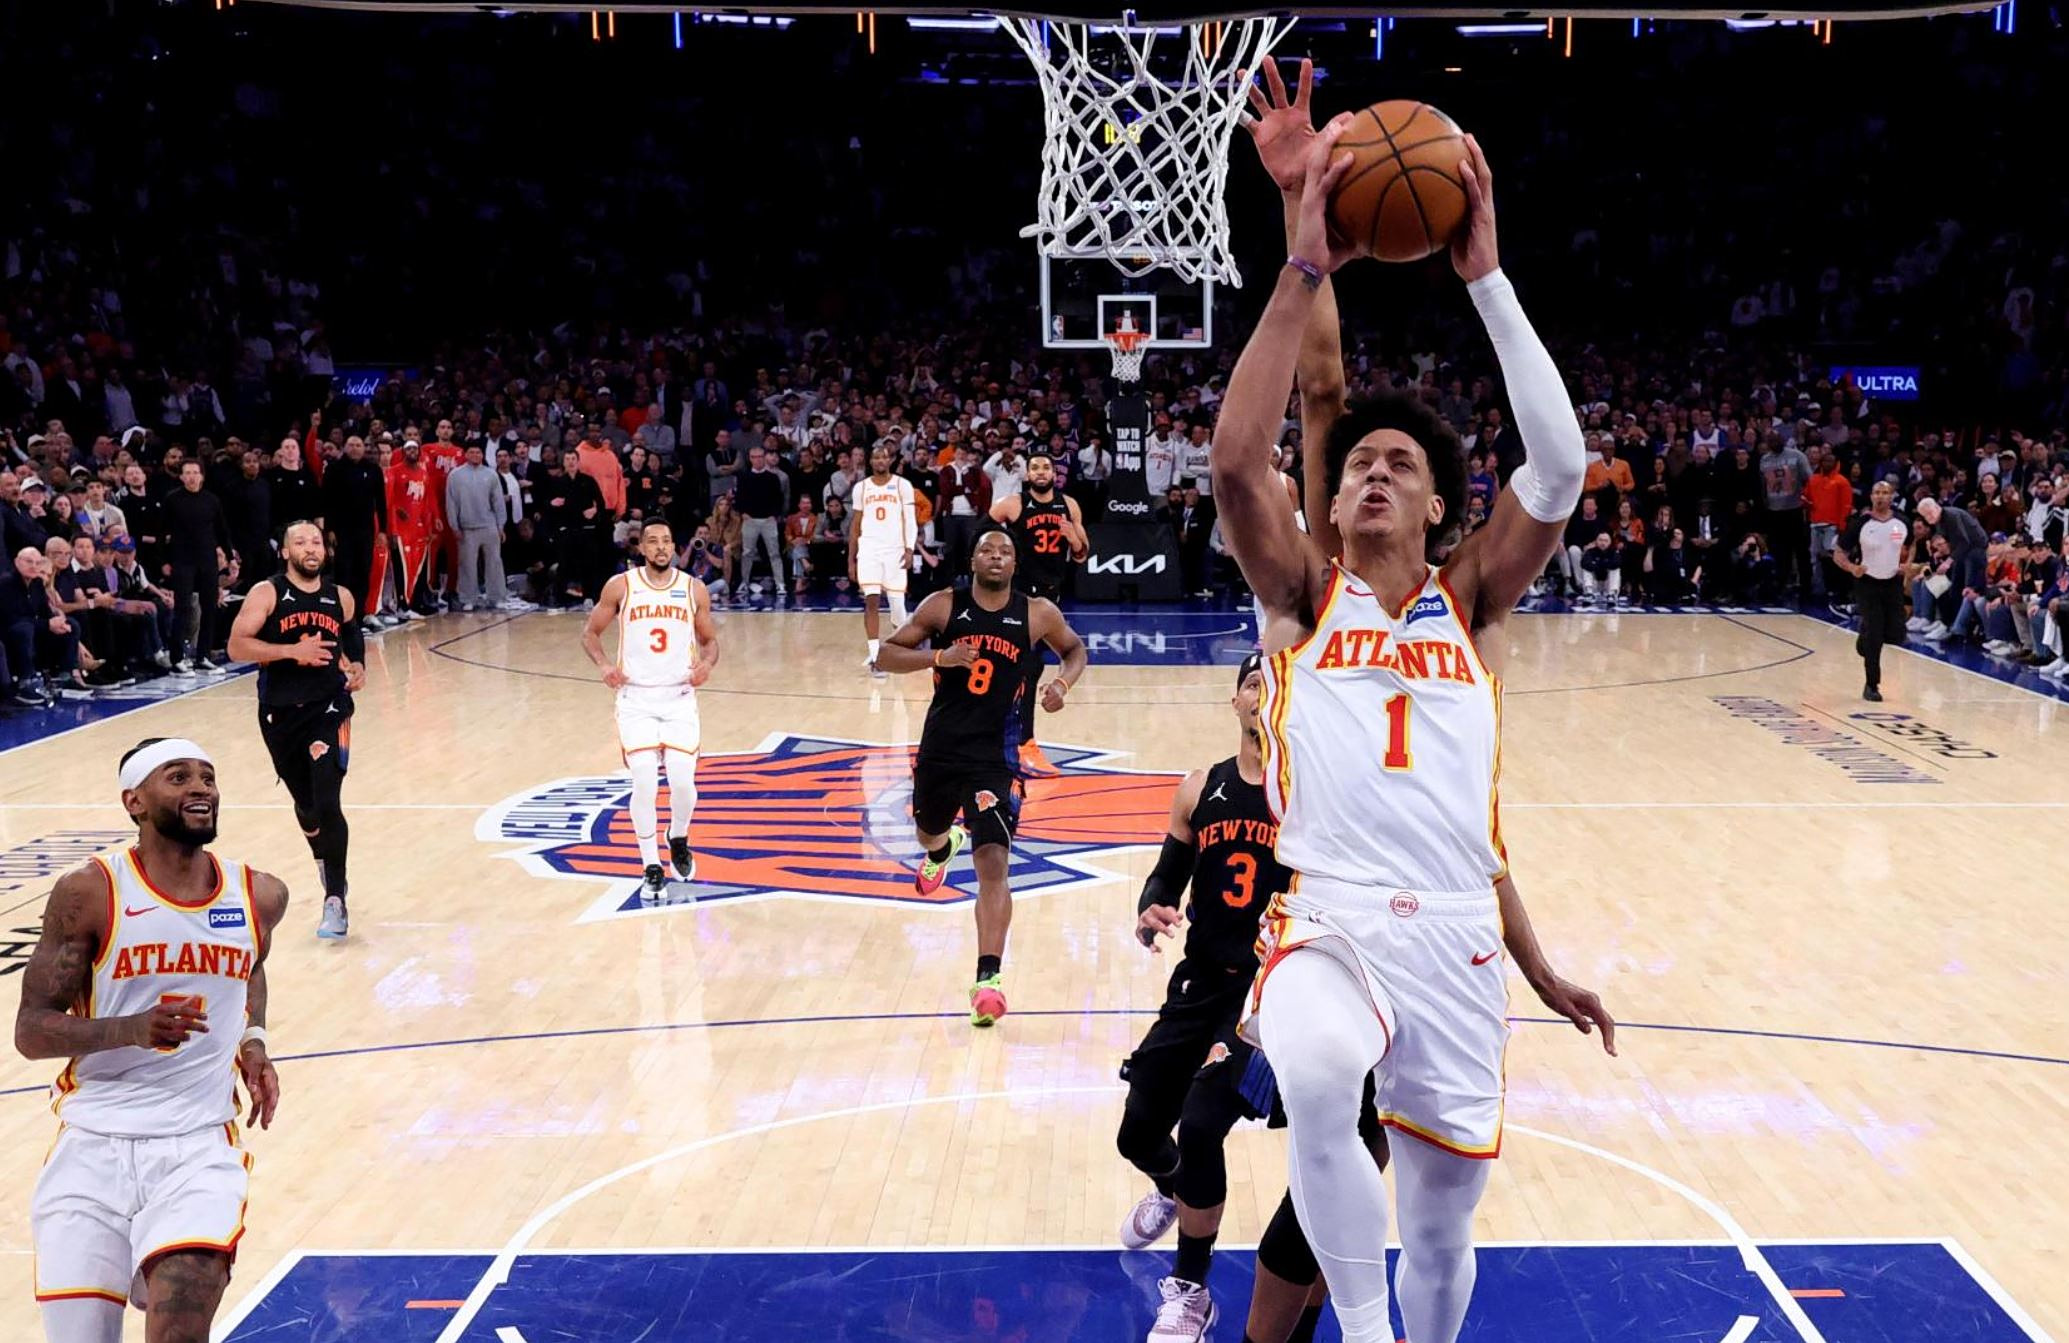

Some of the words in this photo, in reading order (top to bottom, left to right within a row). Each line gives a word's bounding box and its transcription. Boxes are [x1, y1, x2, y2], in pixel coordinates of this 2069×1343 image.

[1857, 376, 1918, 391] ULTRA
[1116, 428, 1130, 440] TAP
[1131, 428, 1140, 440] TO
[1116, 440, 1141, 452] WATCH
[865, 494, 898, 505] ATLANTA
[1108, 500, 1149, 515] Google
[876, 507, 886, 520] 0
[1026, 514, 1046, 530] NEW
[1034, 529, 1061, 553] 32
[1087, 554, 1166, 574] KIA
[629, 604, 689, 622] ATLANTA
[280, 611, 309, 634] NEW
[309, 611, 340, 637] YORK
[649, 628, 668, 654] 3
[984, 635, 1020, 663] YORK
[967, 659, 994, 695] 8
[1384, 693, 1413, 771] 1
[500, 811, 591, 841] NEW
[1198, 819, 1242, 854] NEW
[1243, 819, 1278, 849] YOR
[1222, 852, 1257, 908] 3
[1389, 898, 1420, 911] HAWKS
[210, 913, 243, 924] paze
[111, 943, 252, 981] ATLANTA
